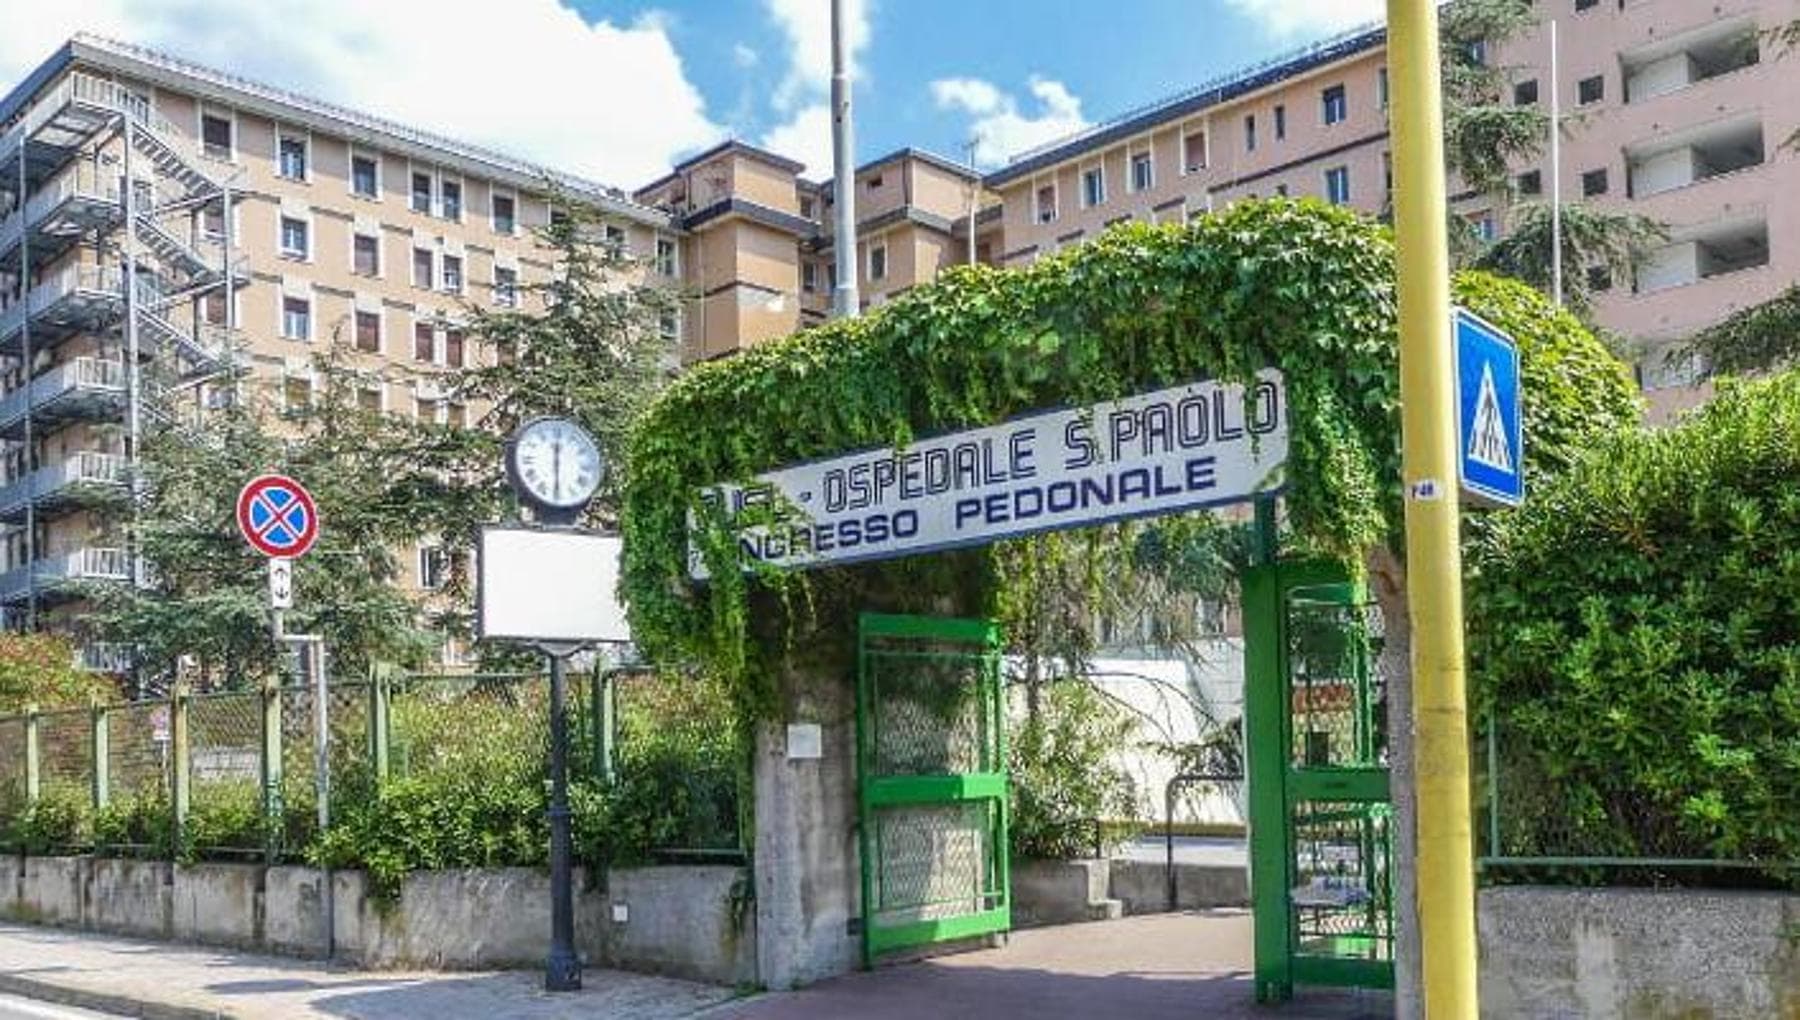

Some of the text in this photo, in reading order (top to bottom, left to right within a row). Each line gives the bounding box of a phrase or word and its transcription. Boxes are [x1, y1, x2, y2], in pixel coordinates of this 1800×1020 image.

[738, 456, 1217, 561] NGRESSO PEDONALE
[823, 428, 1037, 513] OSPEDALE
